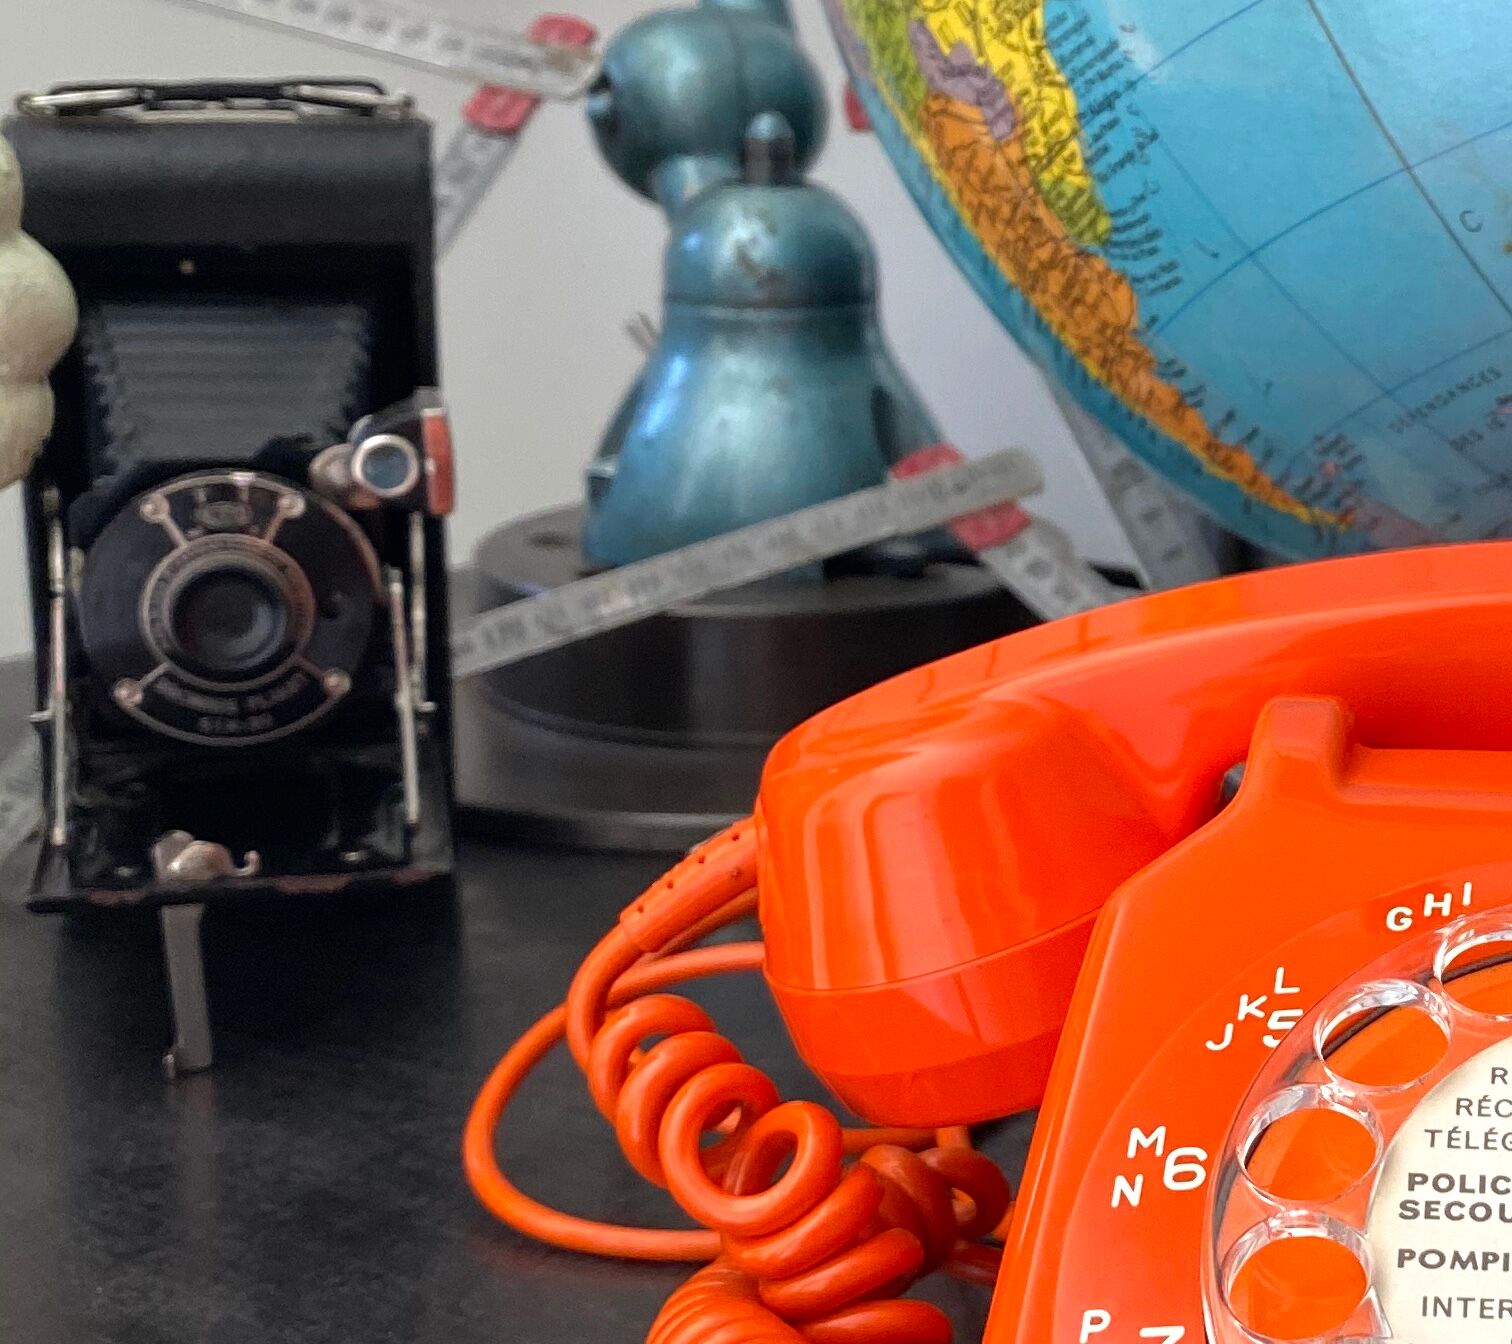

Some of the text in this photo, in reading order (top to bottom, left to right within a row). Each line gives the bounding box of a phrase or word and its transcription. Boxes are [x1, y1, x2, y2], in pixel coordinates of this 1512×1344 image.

[1385, 881, 1473, 933] GHI
[1262, 1008, 1304, 1048] 5
[1163, 1146, 1208, 1191] 6
